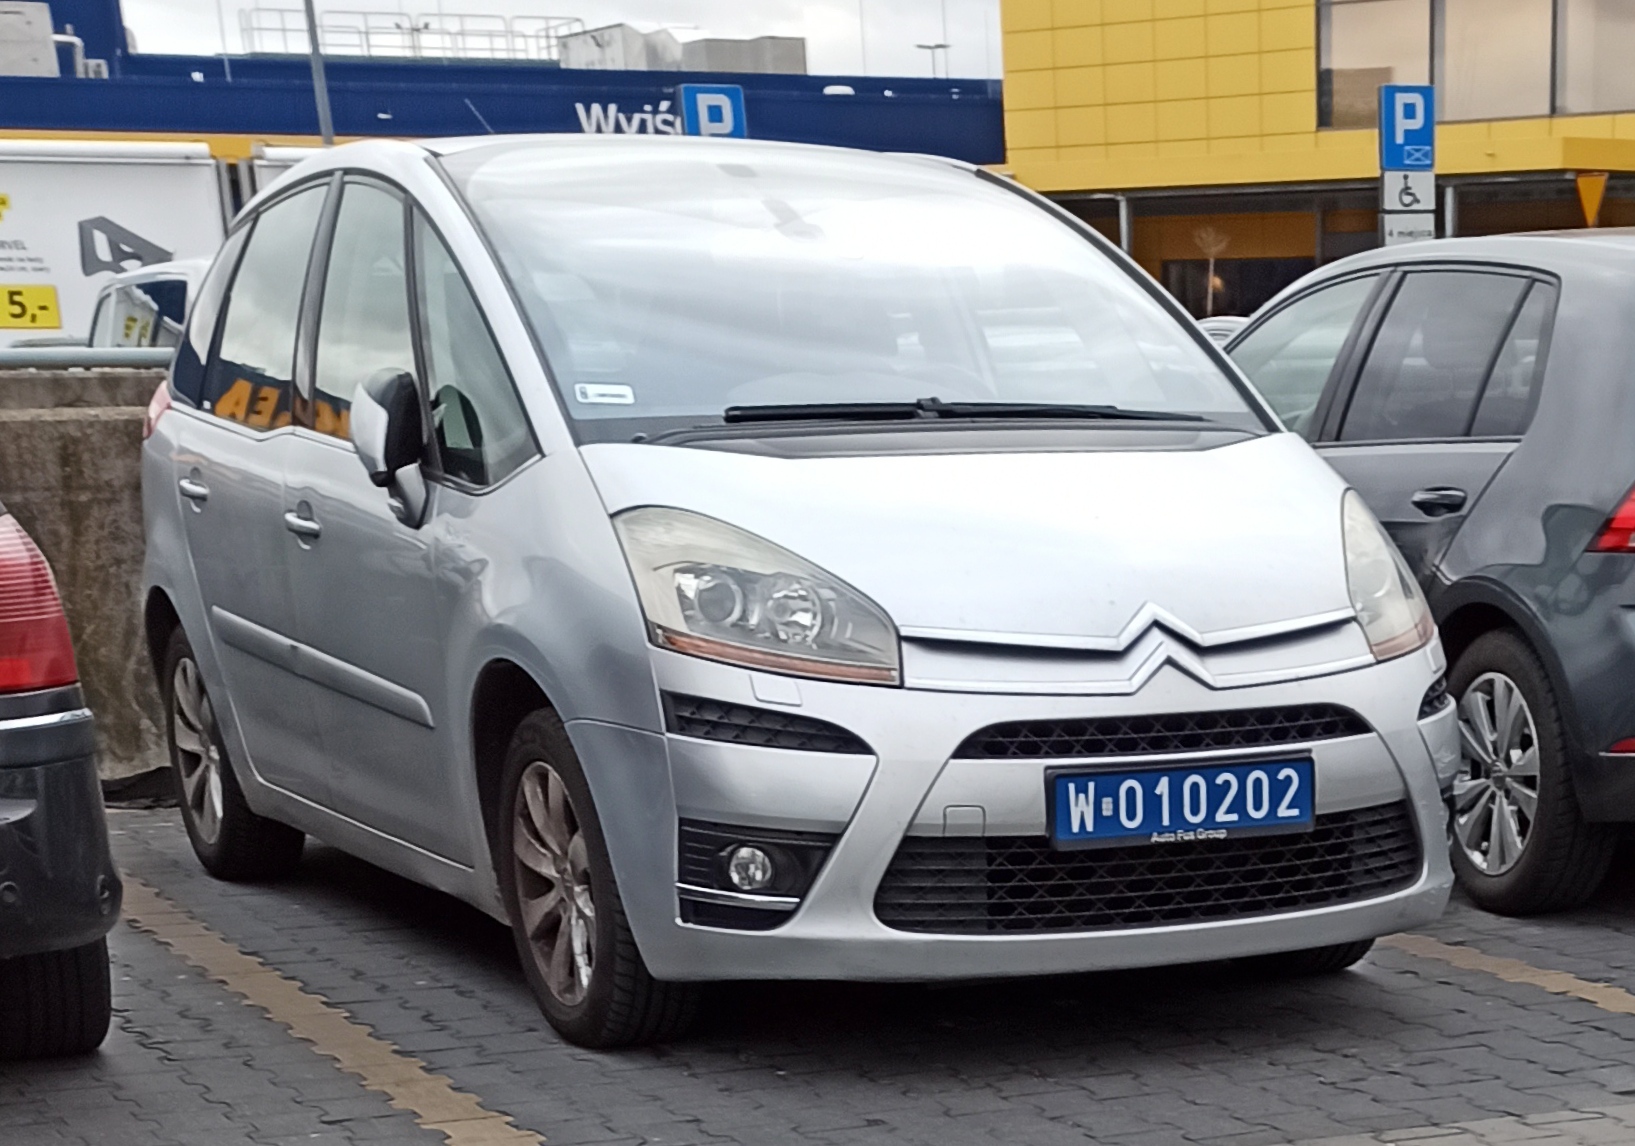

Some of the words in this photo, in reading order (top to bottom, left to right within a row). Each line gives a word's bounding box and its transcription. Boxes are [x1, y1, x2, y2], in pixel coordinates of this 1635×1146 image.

[696, 93, 734, 136] P
[1394, 92, 1425, 145] P
[1068, 781, 1095, 834] W
[1119, 768, 1300, 829] 010202
[1150, 832, 1175, 844] Auto
[1196, 827, 1228, 840] Group
